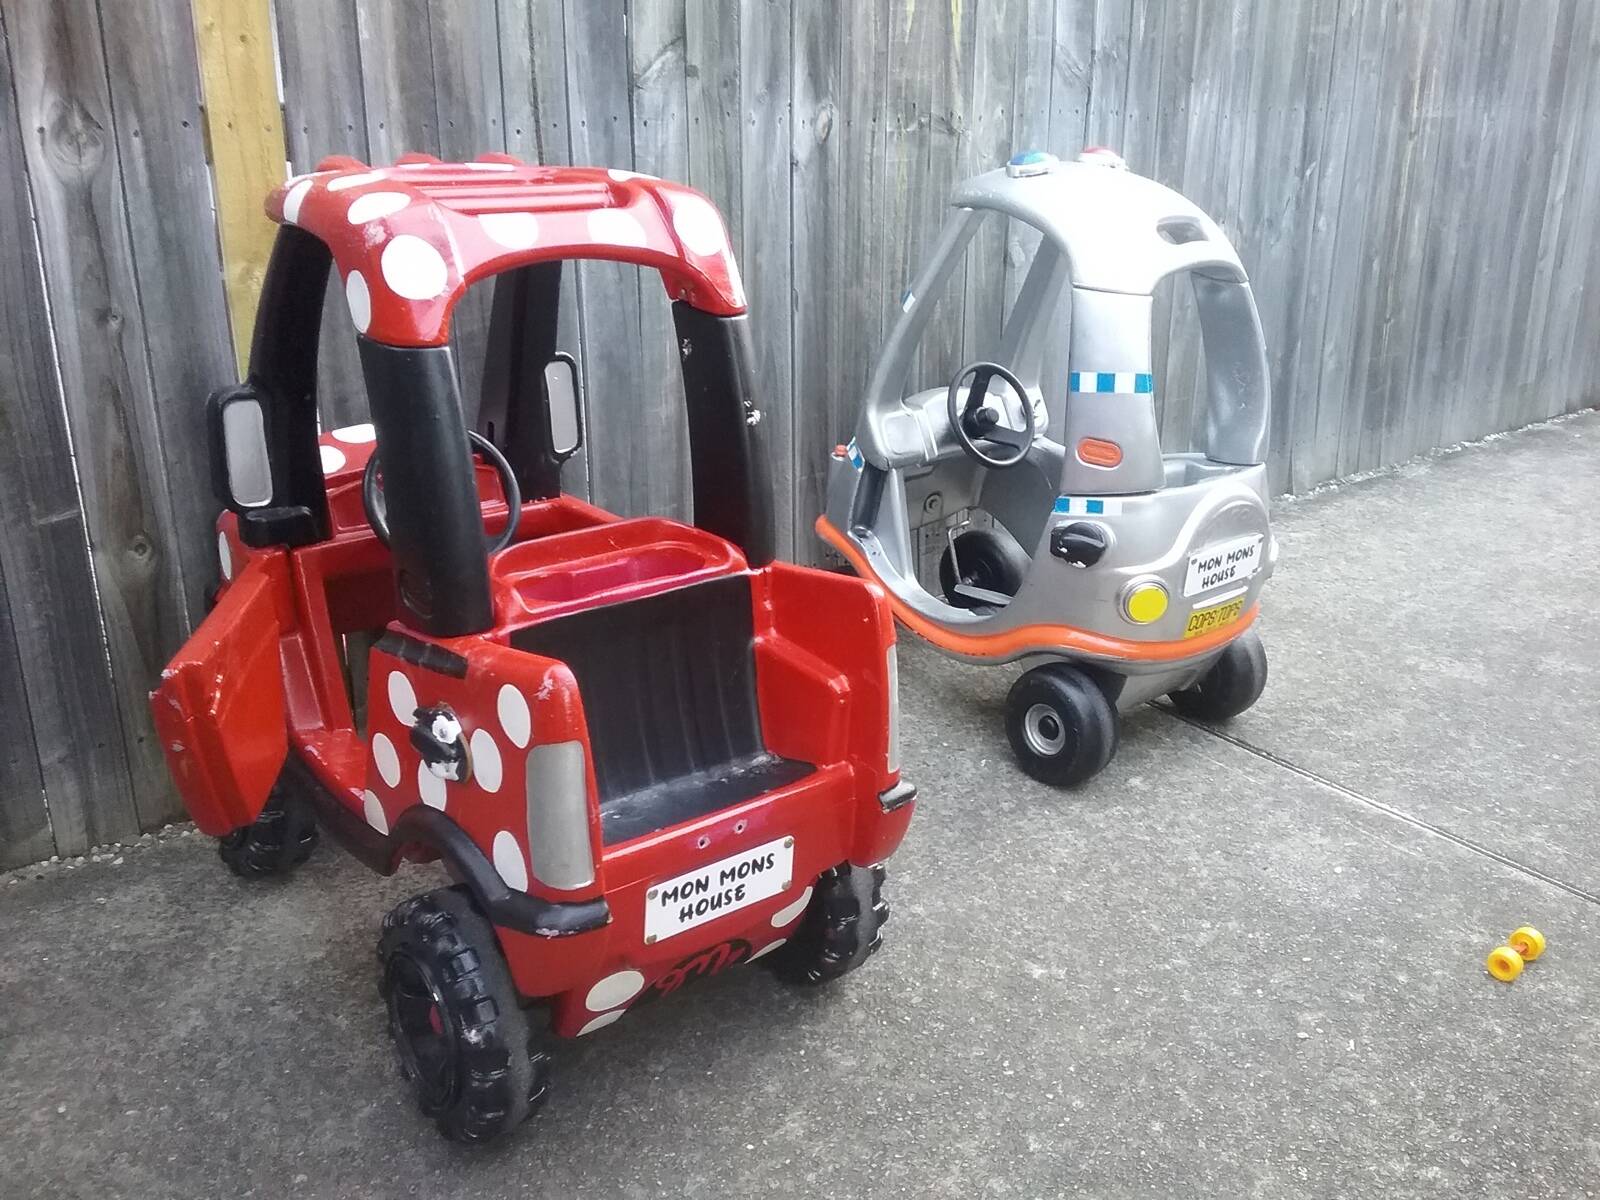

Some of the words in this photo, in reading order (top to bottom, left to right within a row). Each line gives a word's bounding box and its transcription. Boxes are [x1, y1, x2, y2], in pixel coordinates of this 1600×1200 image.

[1197, 555, 1222, 574] MON
[1226, 545, 1255, 565] MONS
[1201, 565, 1237, 589] HOUSE
[661, 875, 710, 907] MON
[719, 853, 775, 885] MONS
[678, 883, 746, 923] HOUSE
